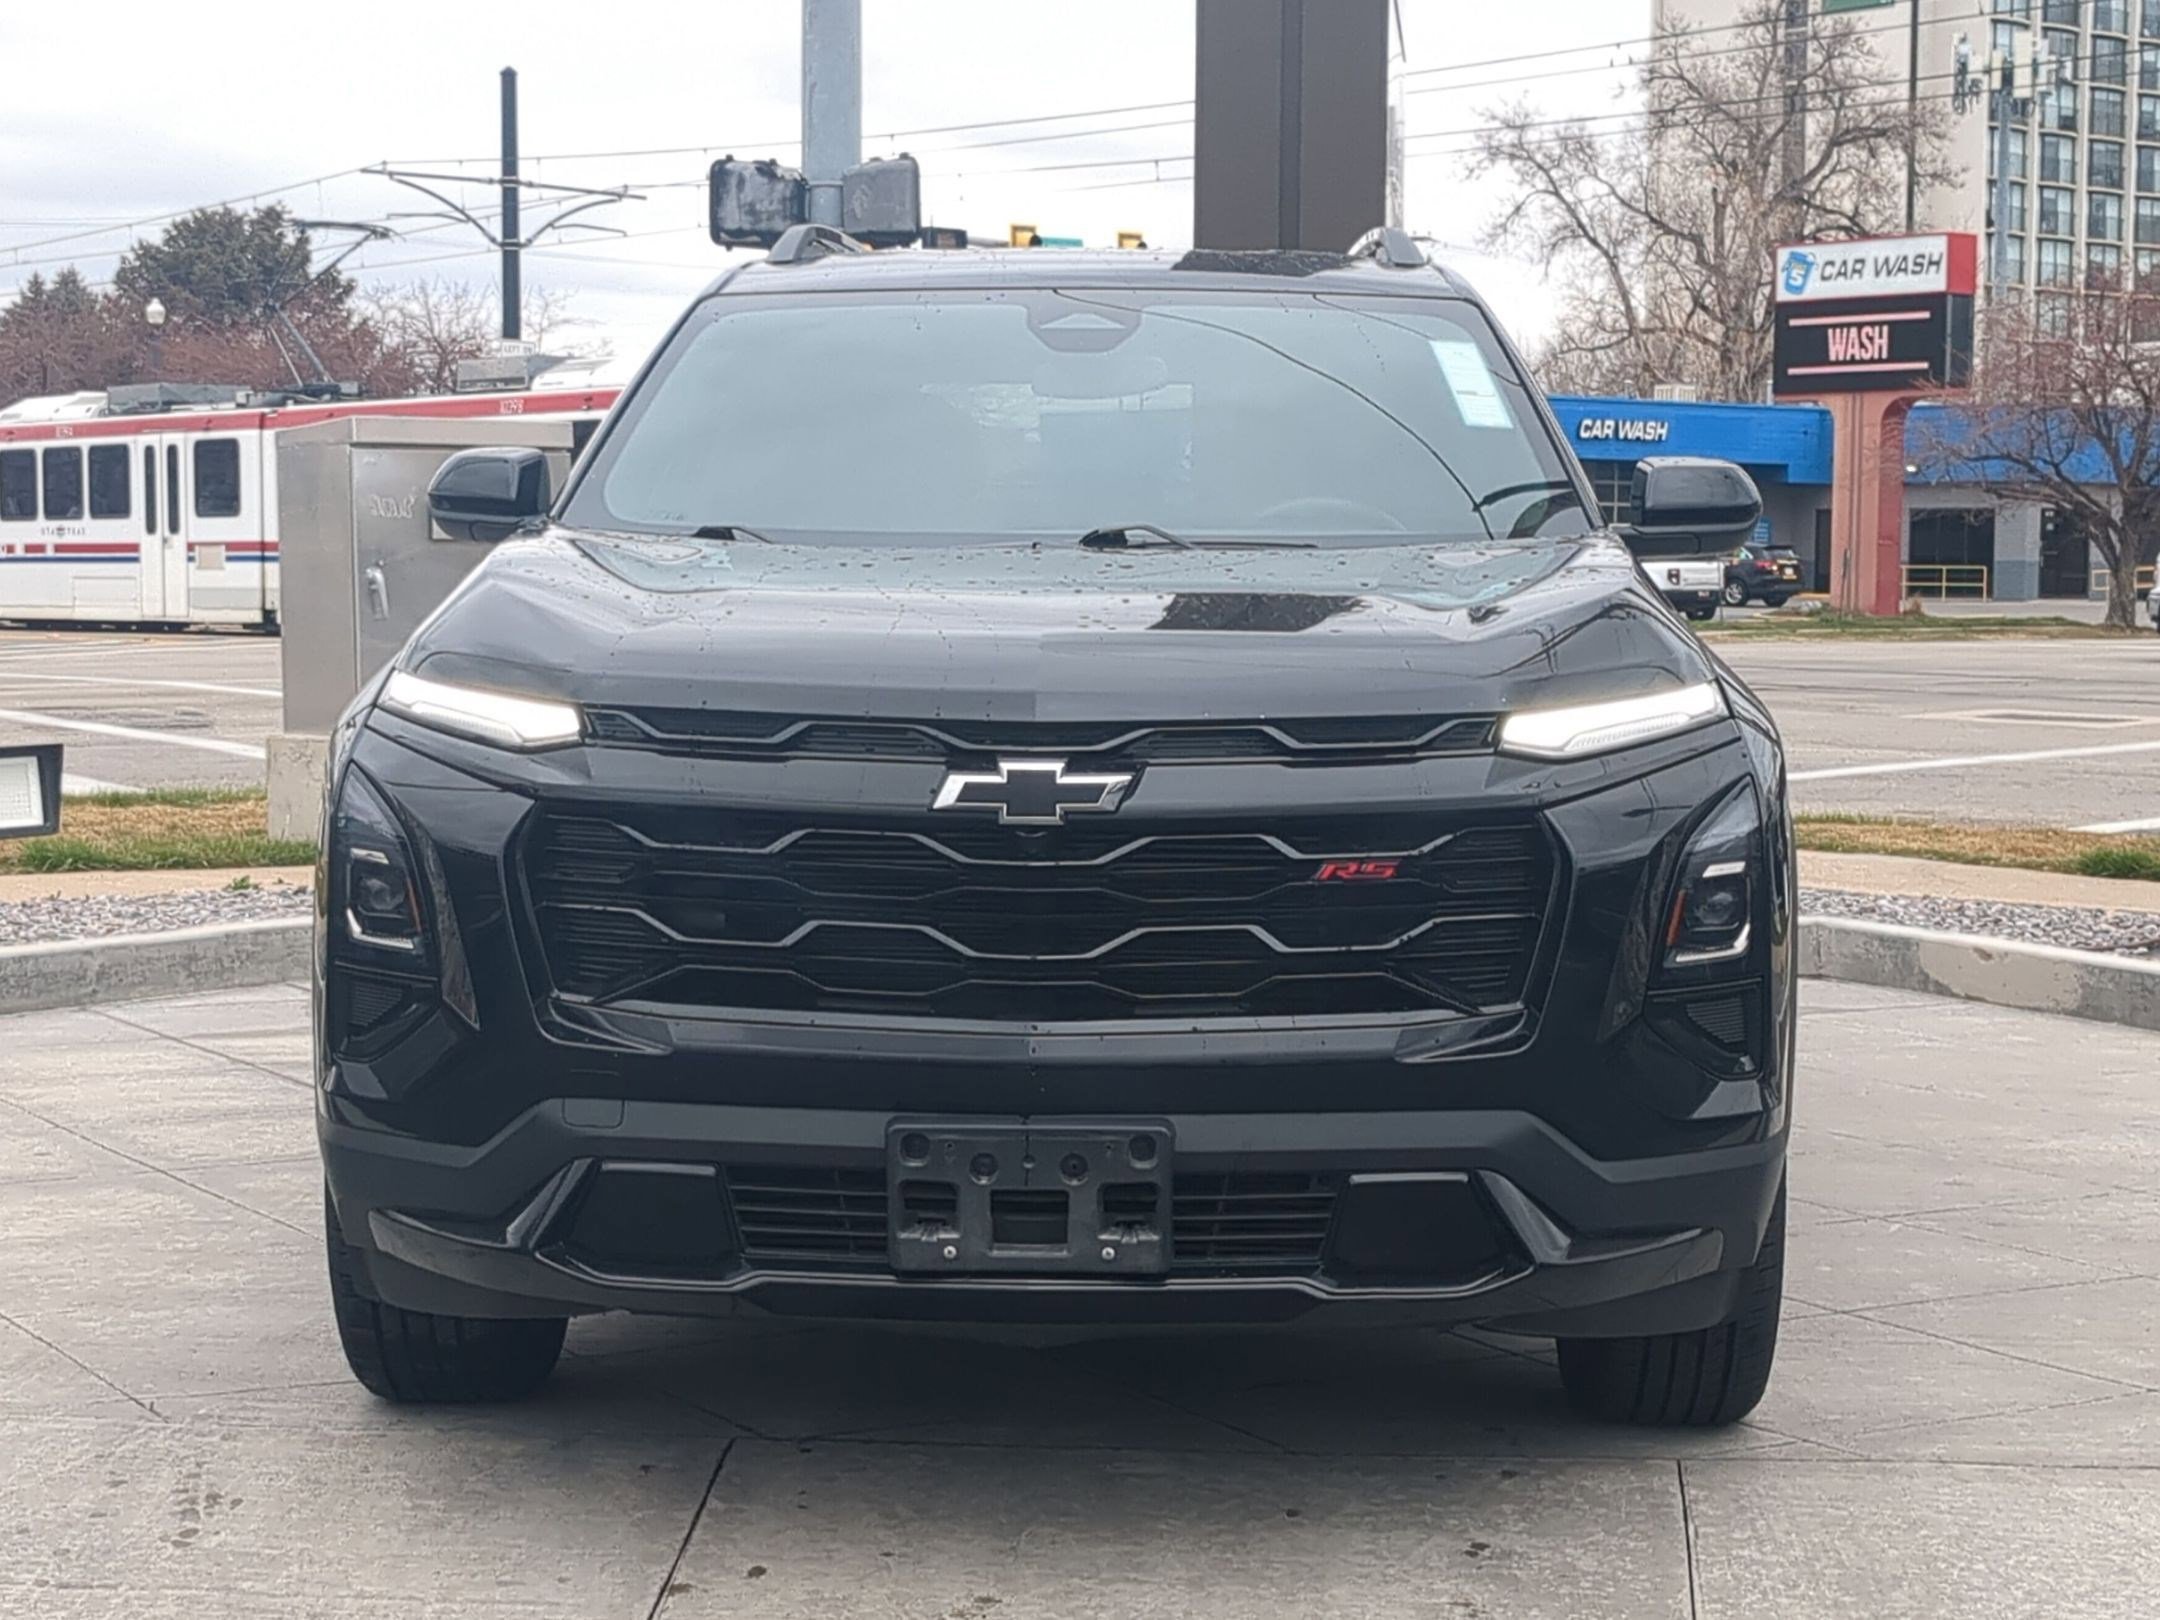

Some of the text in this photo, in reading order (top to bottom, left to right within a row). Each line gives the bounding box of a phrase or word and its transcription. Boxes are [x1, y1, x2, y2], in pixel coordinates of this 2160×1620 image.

[1820, 258, 1866, 281] CAR
[1874, 252, 1943, 278] WASH
[1827, 325, 1889, 361] WASH
[1580, 418, 1669, 441] CAR WASH
[1314, 859, 1399, 881] RS
